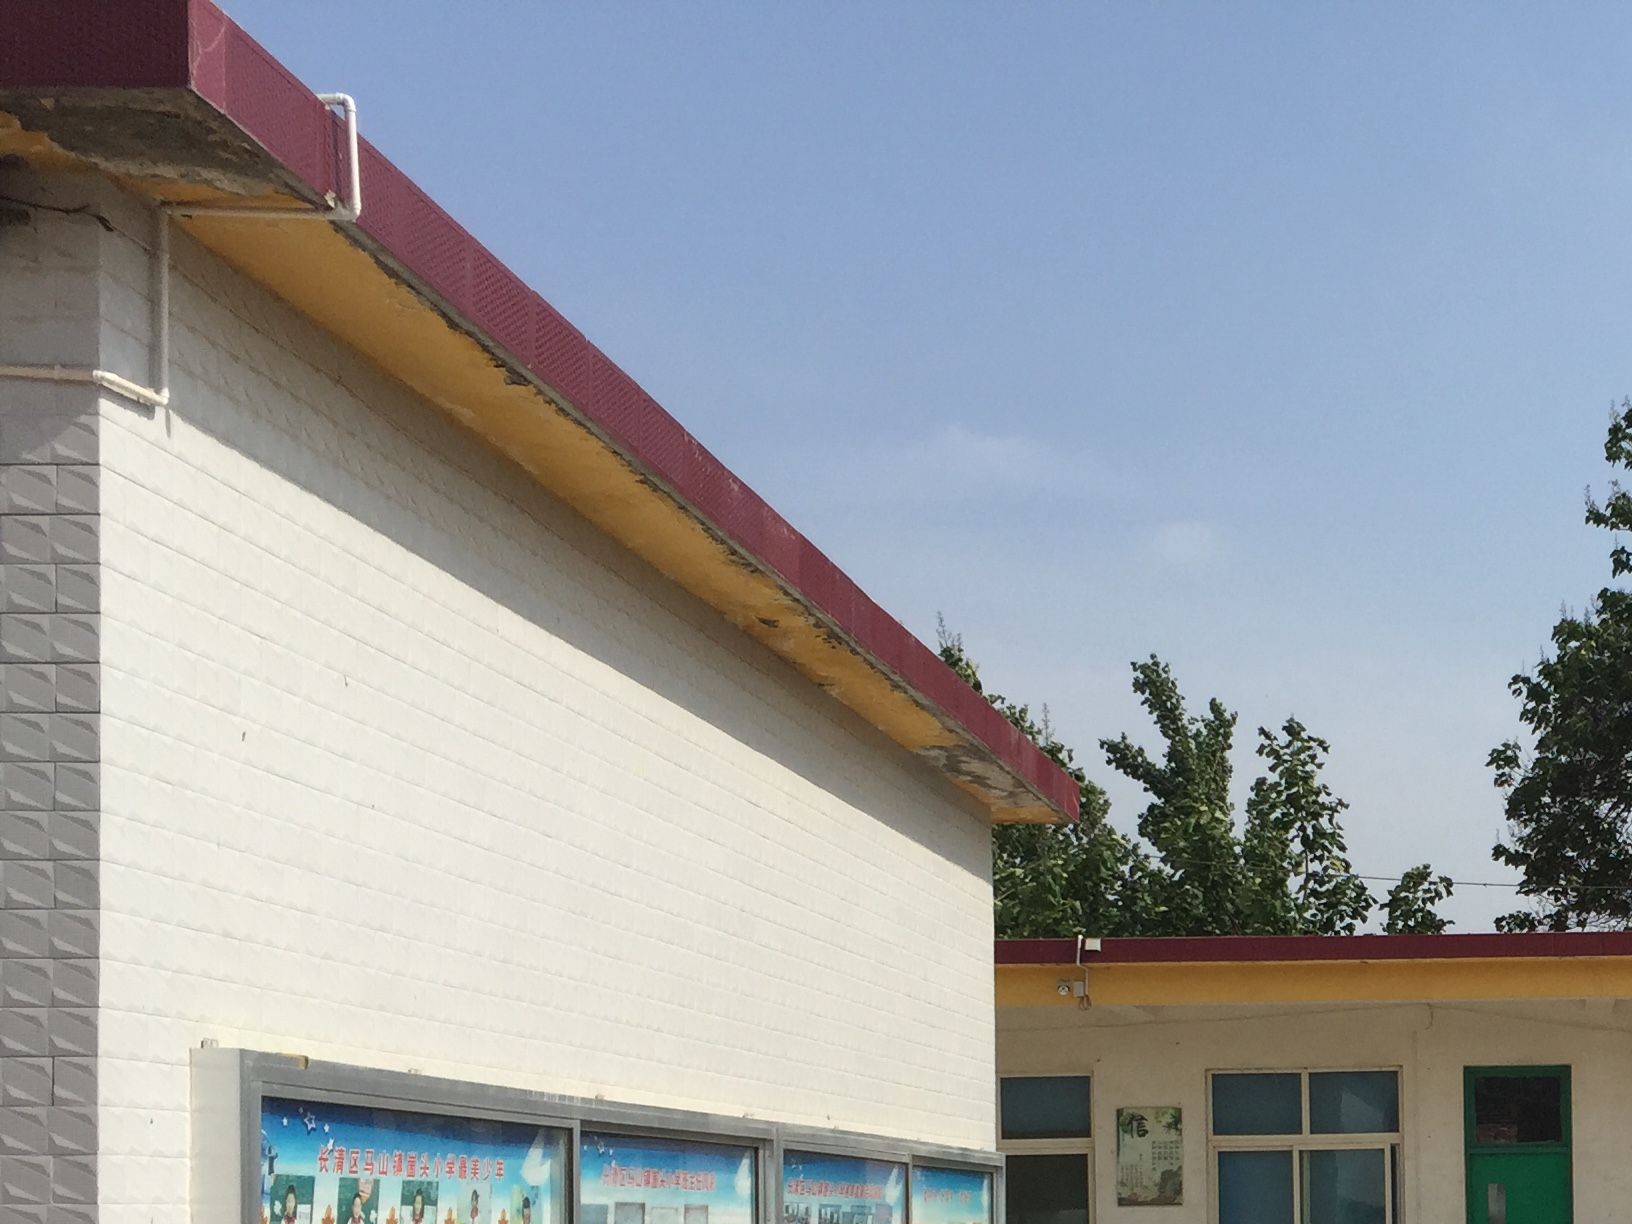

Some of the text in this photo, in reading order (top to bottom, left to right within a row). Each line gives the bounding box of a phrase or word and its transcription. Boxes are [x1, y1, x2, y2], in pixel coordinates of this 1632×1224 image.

[1127, 1113, 1149, 1138] 信
[318, 1146, 504, 1181] 长清区马山镇崮头小学最美少年
